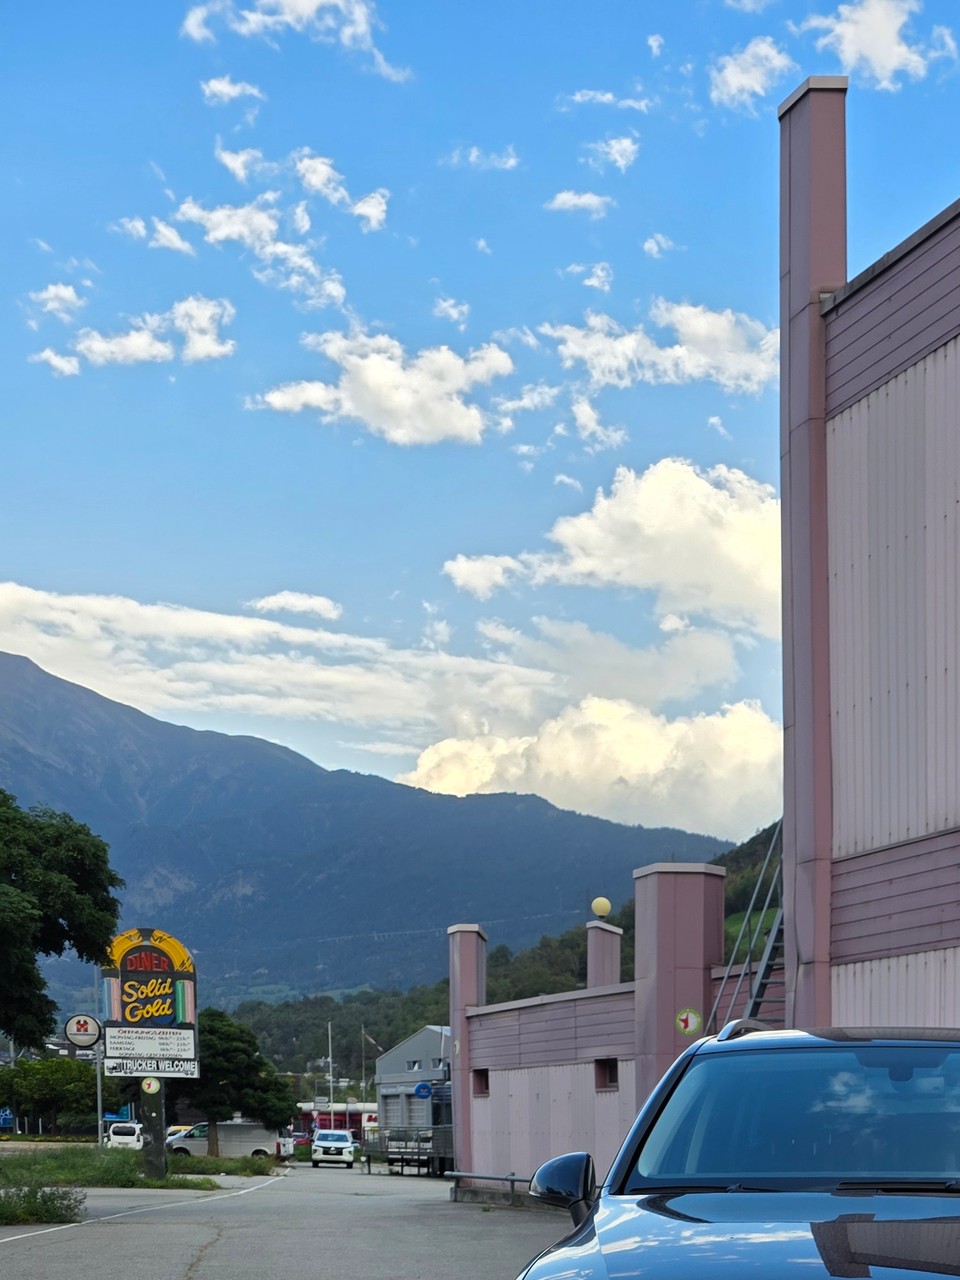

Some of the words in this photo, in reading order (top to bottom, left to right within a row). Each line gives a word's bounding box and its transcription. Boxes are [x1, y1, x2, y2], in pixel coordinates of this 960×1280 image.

[127, 951, 169, 971] DINER
[122, 977, 173, 1003] Solid
[124, 998, 173, 1023] Gold
[122, 1060, 157, 1071] TRUCKER
[158, 1060, 196, 1071] WELCOME
